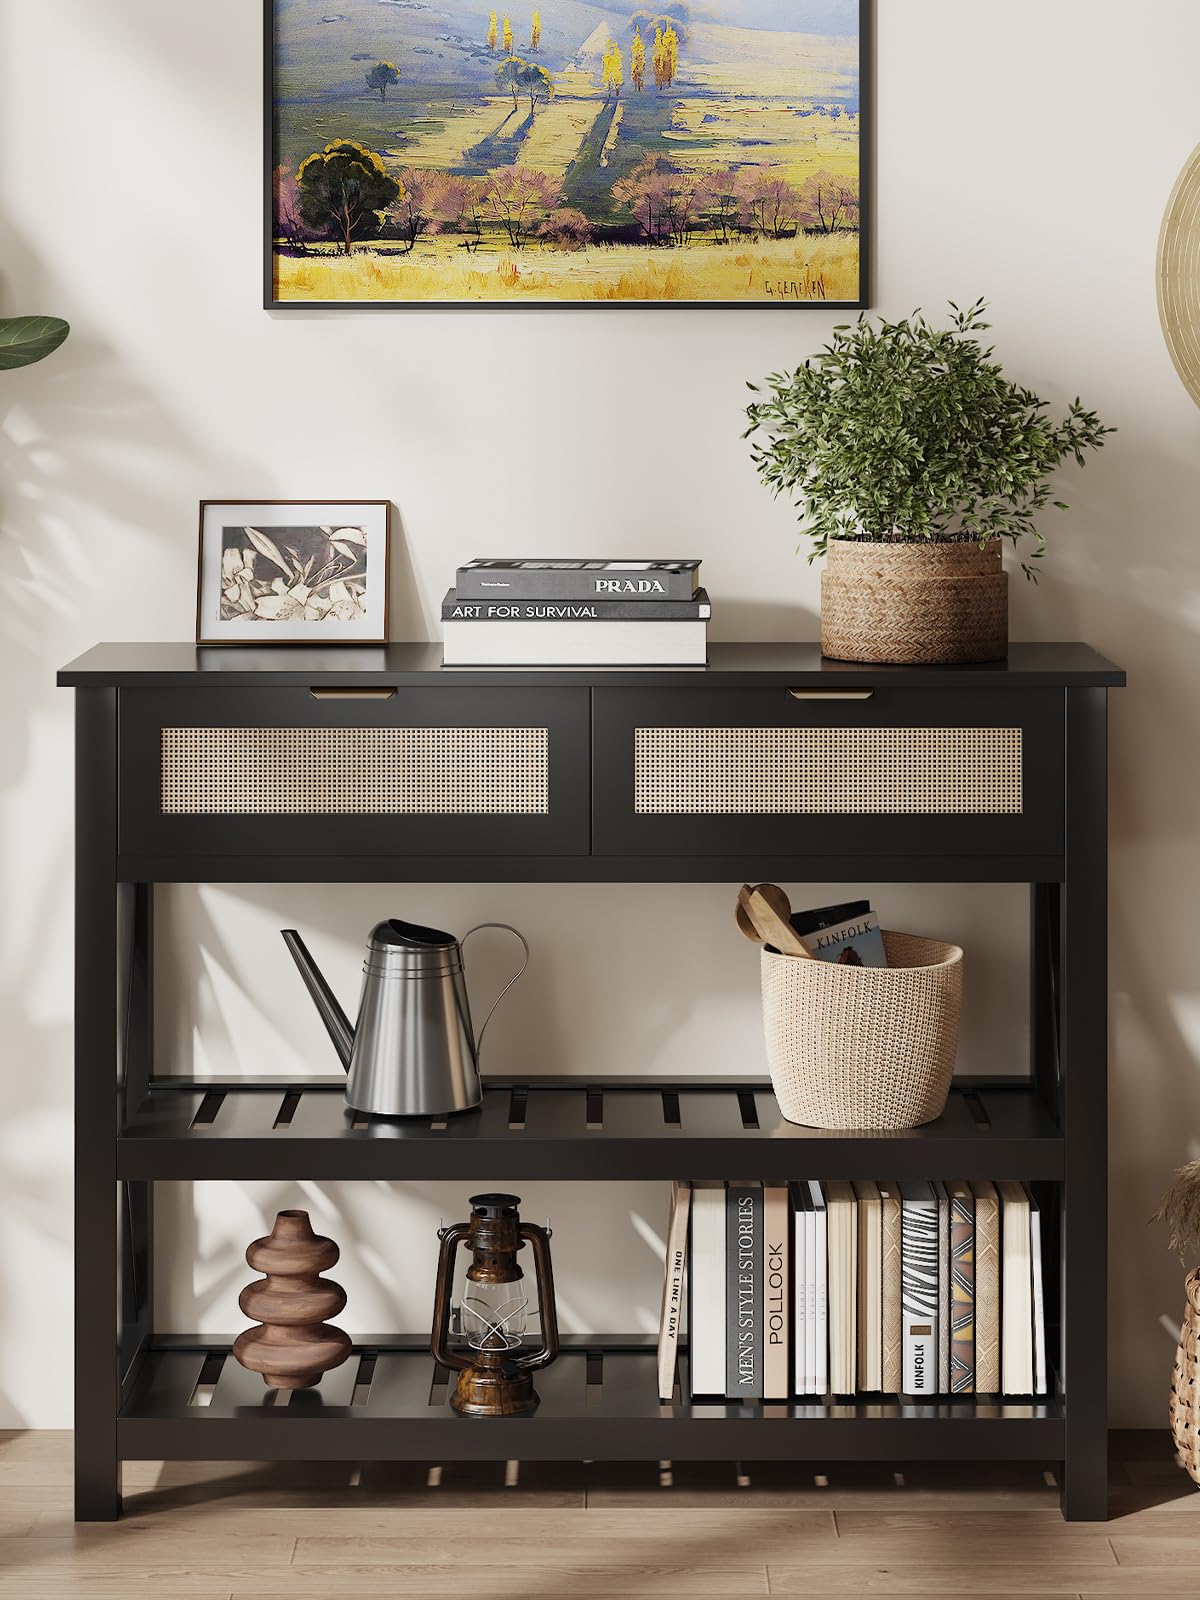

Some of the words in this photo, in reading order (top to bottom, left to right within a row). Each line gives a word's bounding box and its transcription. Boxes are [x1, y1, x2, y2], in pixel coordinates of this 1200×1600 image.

[595, 579, 665, 593] PRADA
[451, 606, 482, 618] ART
[487, 606, 521, 618] FOR
[525, 606, 598, 618] SURVIVAL
[816, 921, 872, 949] KINFOLK
[738, 1196, 753, 1270] STORIES
[672, 1278, 680, 1302] LINE
[738, 1273, 754, 1328] STYLE
[769, 1242, 783, 1345] POLLOCK
[668, 1317, 676, 1339] DAY
[914, 1344, 924, 1389] KINFOLK
